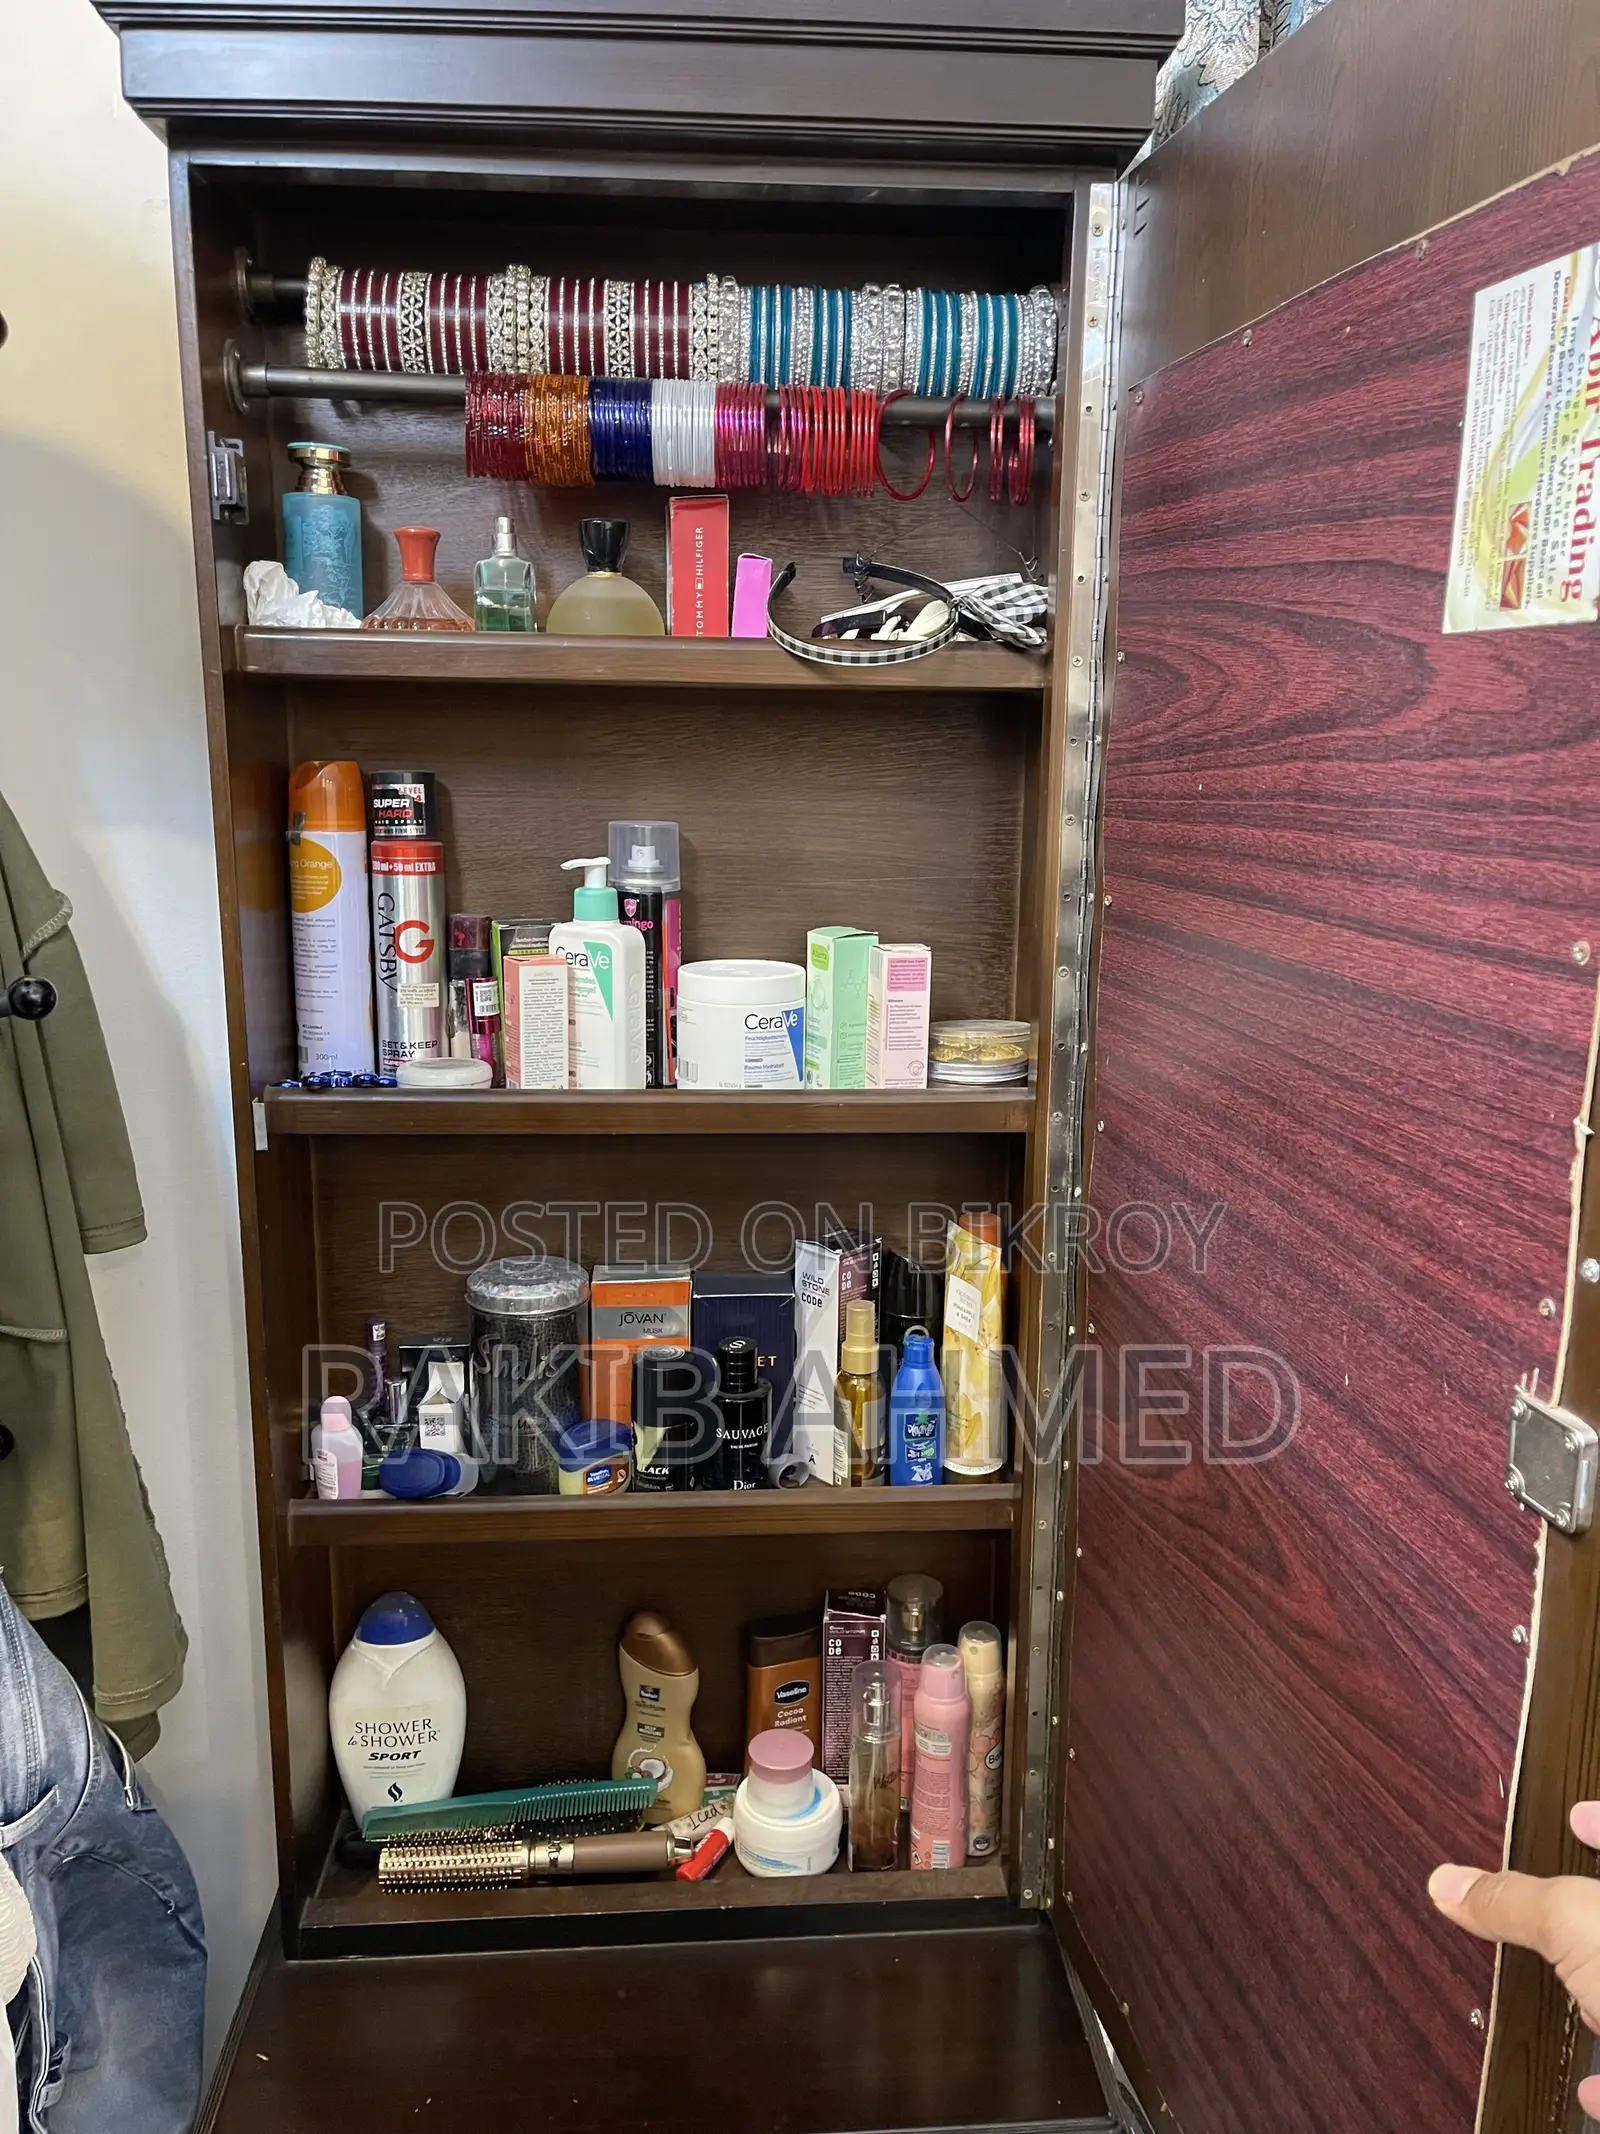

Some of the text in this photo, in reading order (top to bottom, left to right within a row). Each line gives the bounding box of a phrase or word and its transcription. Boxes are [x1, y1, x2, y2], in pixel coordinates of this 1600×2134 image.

[1546, 343, 1555, 386] Board
[1562, 314, 1580, 423] Importer
[1572, 351, 1585, 420] Change
[1550, 399, 1562, 452] Veneer
[1538, 403, 1551, 469] Furniture
[1553, 456, 1568, 528] Whole
[1530, 472, 1544, 540] Hardware
[1541, 503, 1551, 534] MDF
[1559, 436, 1600, 603] Trading
[1537, 538, 1548, 578] Board
[1545, 539, 1560, 597] Saler
[695, 527, 704, 636] TOMMY HILFIGER
[373, 799, 410, 808] SUPER
[378, 809, 413, 818] HARD
[300, 859, 332, 870] Orange
[415, 862, 436, 871] EXTRA
[621, 918, 653, 931] mingo
[378, 893, 397, 992] GATSBY
[393, 920, 434, 963] G
[556, 946, 609, 969] CeraVe
[744, 1011, 798, 1030] CeraVe
[383, 1040, 438, 1050] SET & KEEP
[383, 1049, 414, 1058] SPRAY
[802, 1271, 824, 1285] WILD
[802, 1280, 830, 1295] STONE
[716, 1423, 768, 1440] SAUVAGE
[808, 1454, 816, 1465] A
[733, 1480, 756, 1490] Dior
[776, 1687, 807, 1699] Vaseline
[774, 1715, 807, 1727] Radiant
[777, 1708, 804, 1718] Cocoa
[355, 1718, 432, 1734] SHOWER
[361, 1731, 438, 1748] SHOWER
[368, 1750, 421, 1761] SPORT
[685, 1804, 722, 1830] Iced
